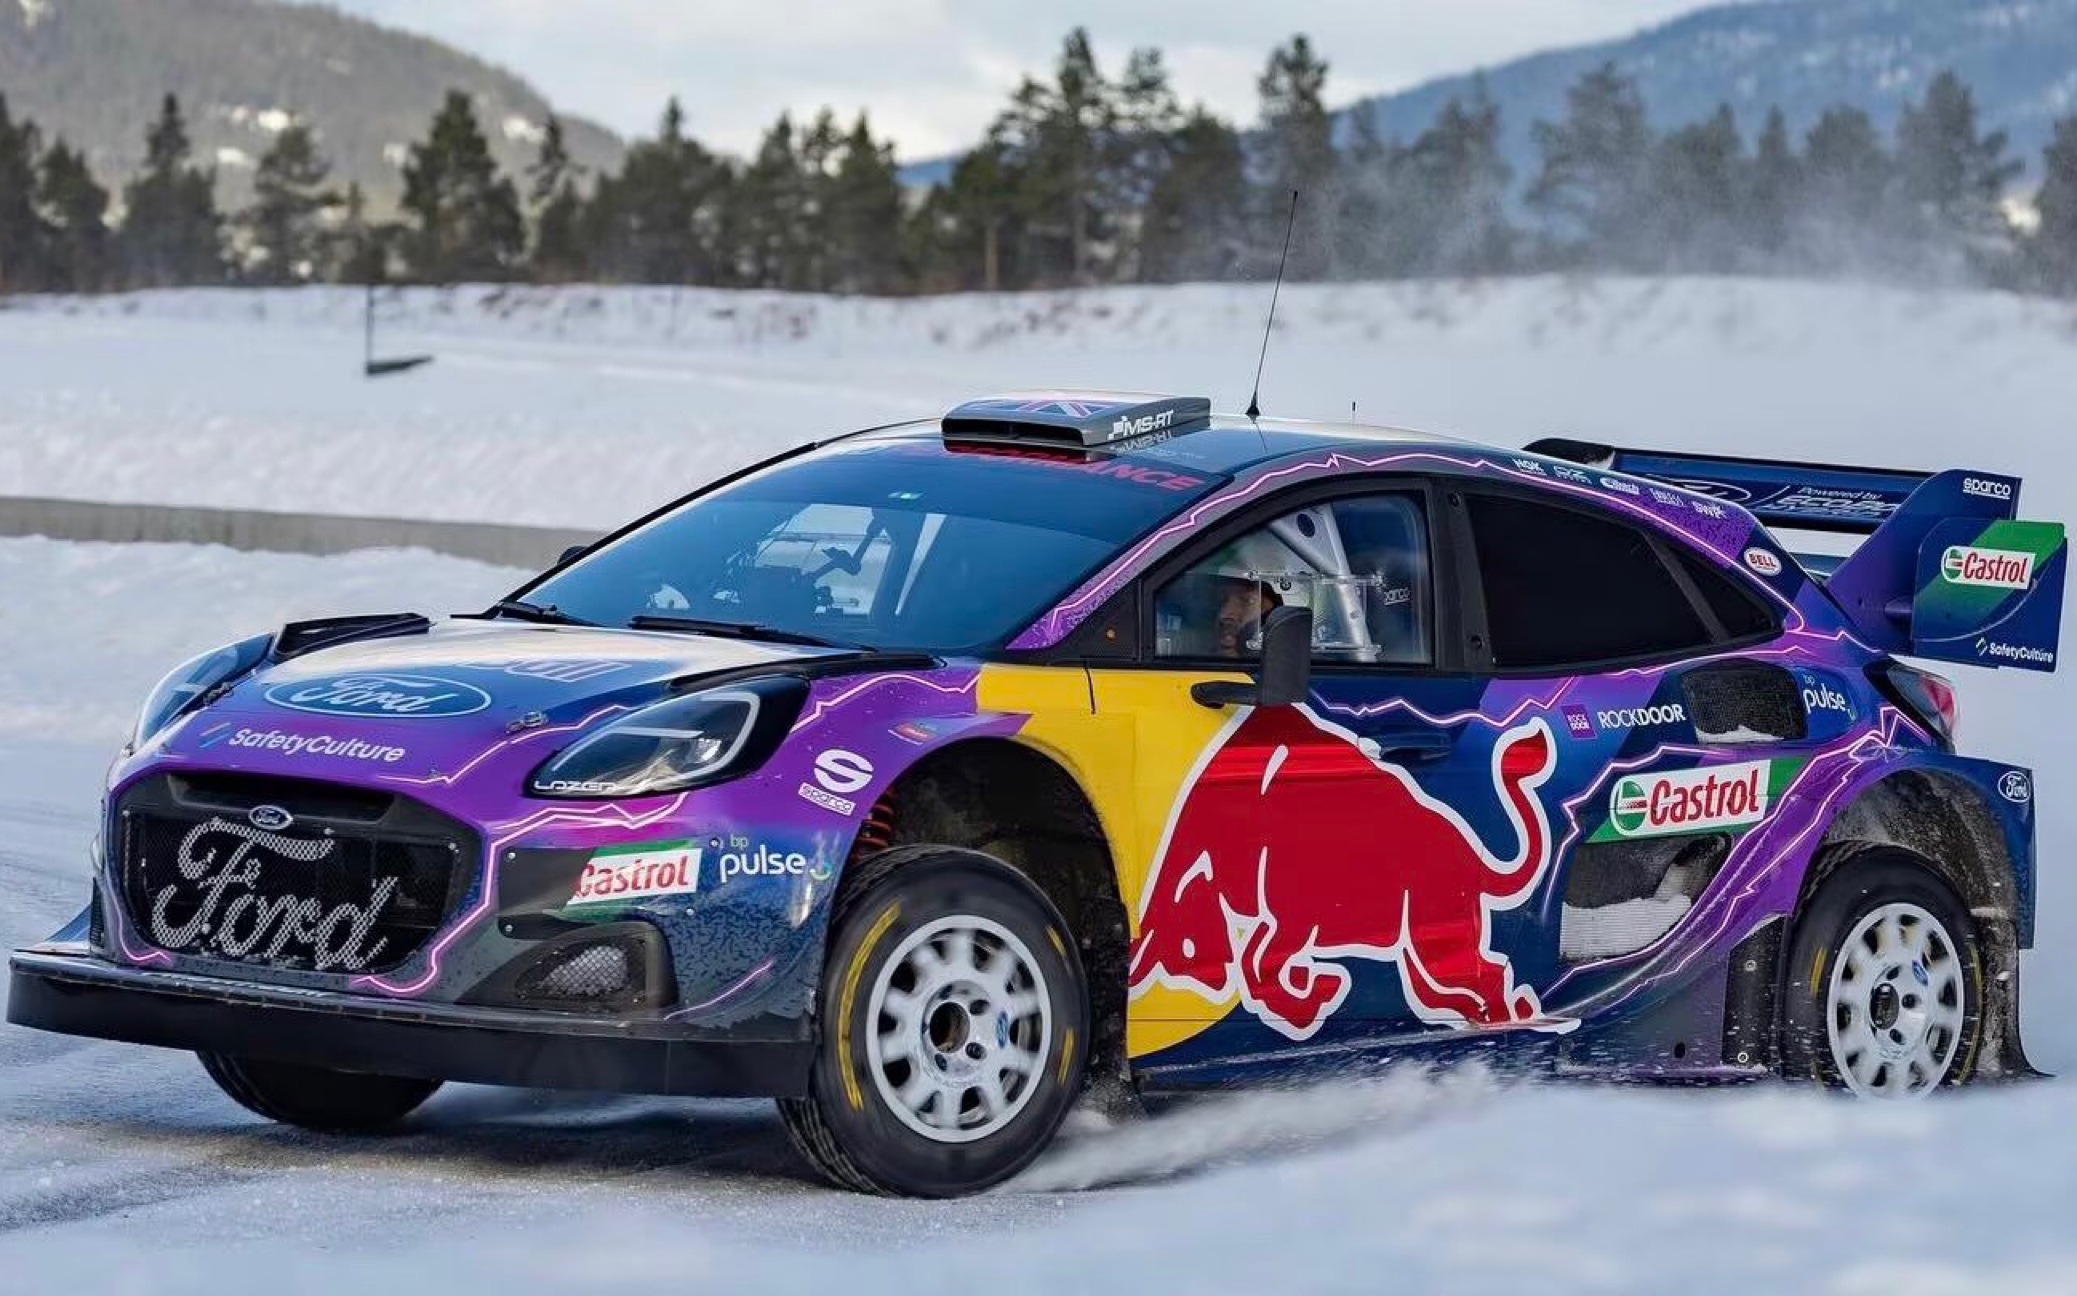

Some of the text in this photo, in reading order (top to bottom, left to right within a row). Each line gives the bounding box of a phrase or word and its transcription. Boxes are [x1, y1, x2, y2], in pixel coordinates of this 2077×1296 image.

[1962, 477, 2012, 499] sparco
[1748, 553, 1777, 568] BELL
[1963, 551, 2029, 584] Castrol
[1989, 642, 2054, 664] SafetyCulture
[289, 675, 460, 713] Ford
[1803, 683, 1847, 714] pulse
[1597, 704, 1687, 729] ROCKDOOR
[228, 727, 407, 763] SafetyCulture
[801, 784, 854, 814] sparco
[1650, 768, 1760, 826] Castrol
[729, 833, 749, 849] bp
[719, 845, 807, 883] pulse
[151, 815, 399, 971] Ford
